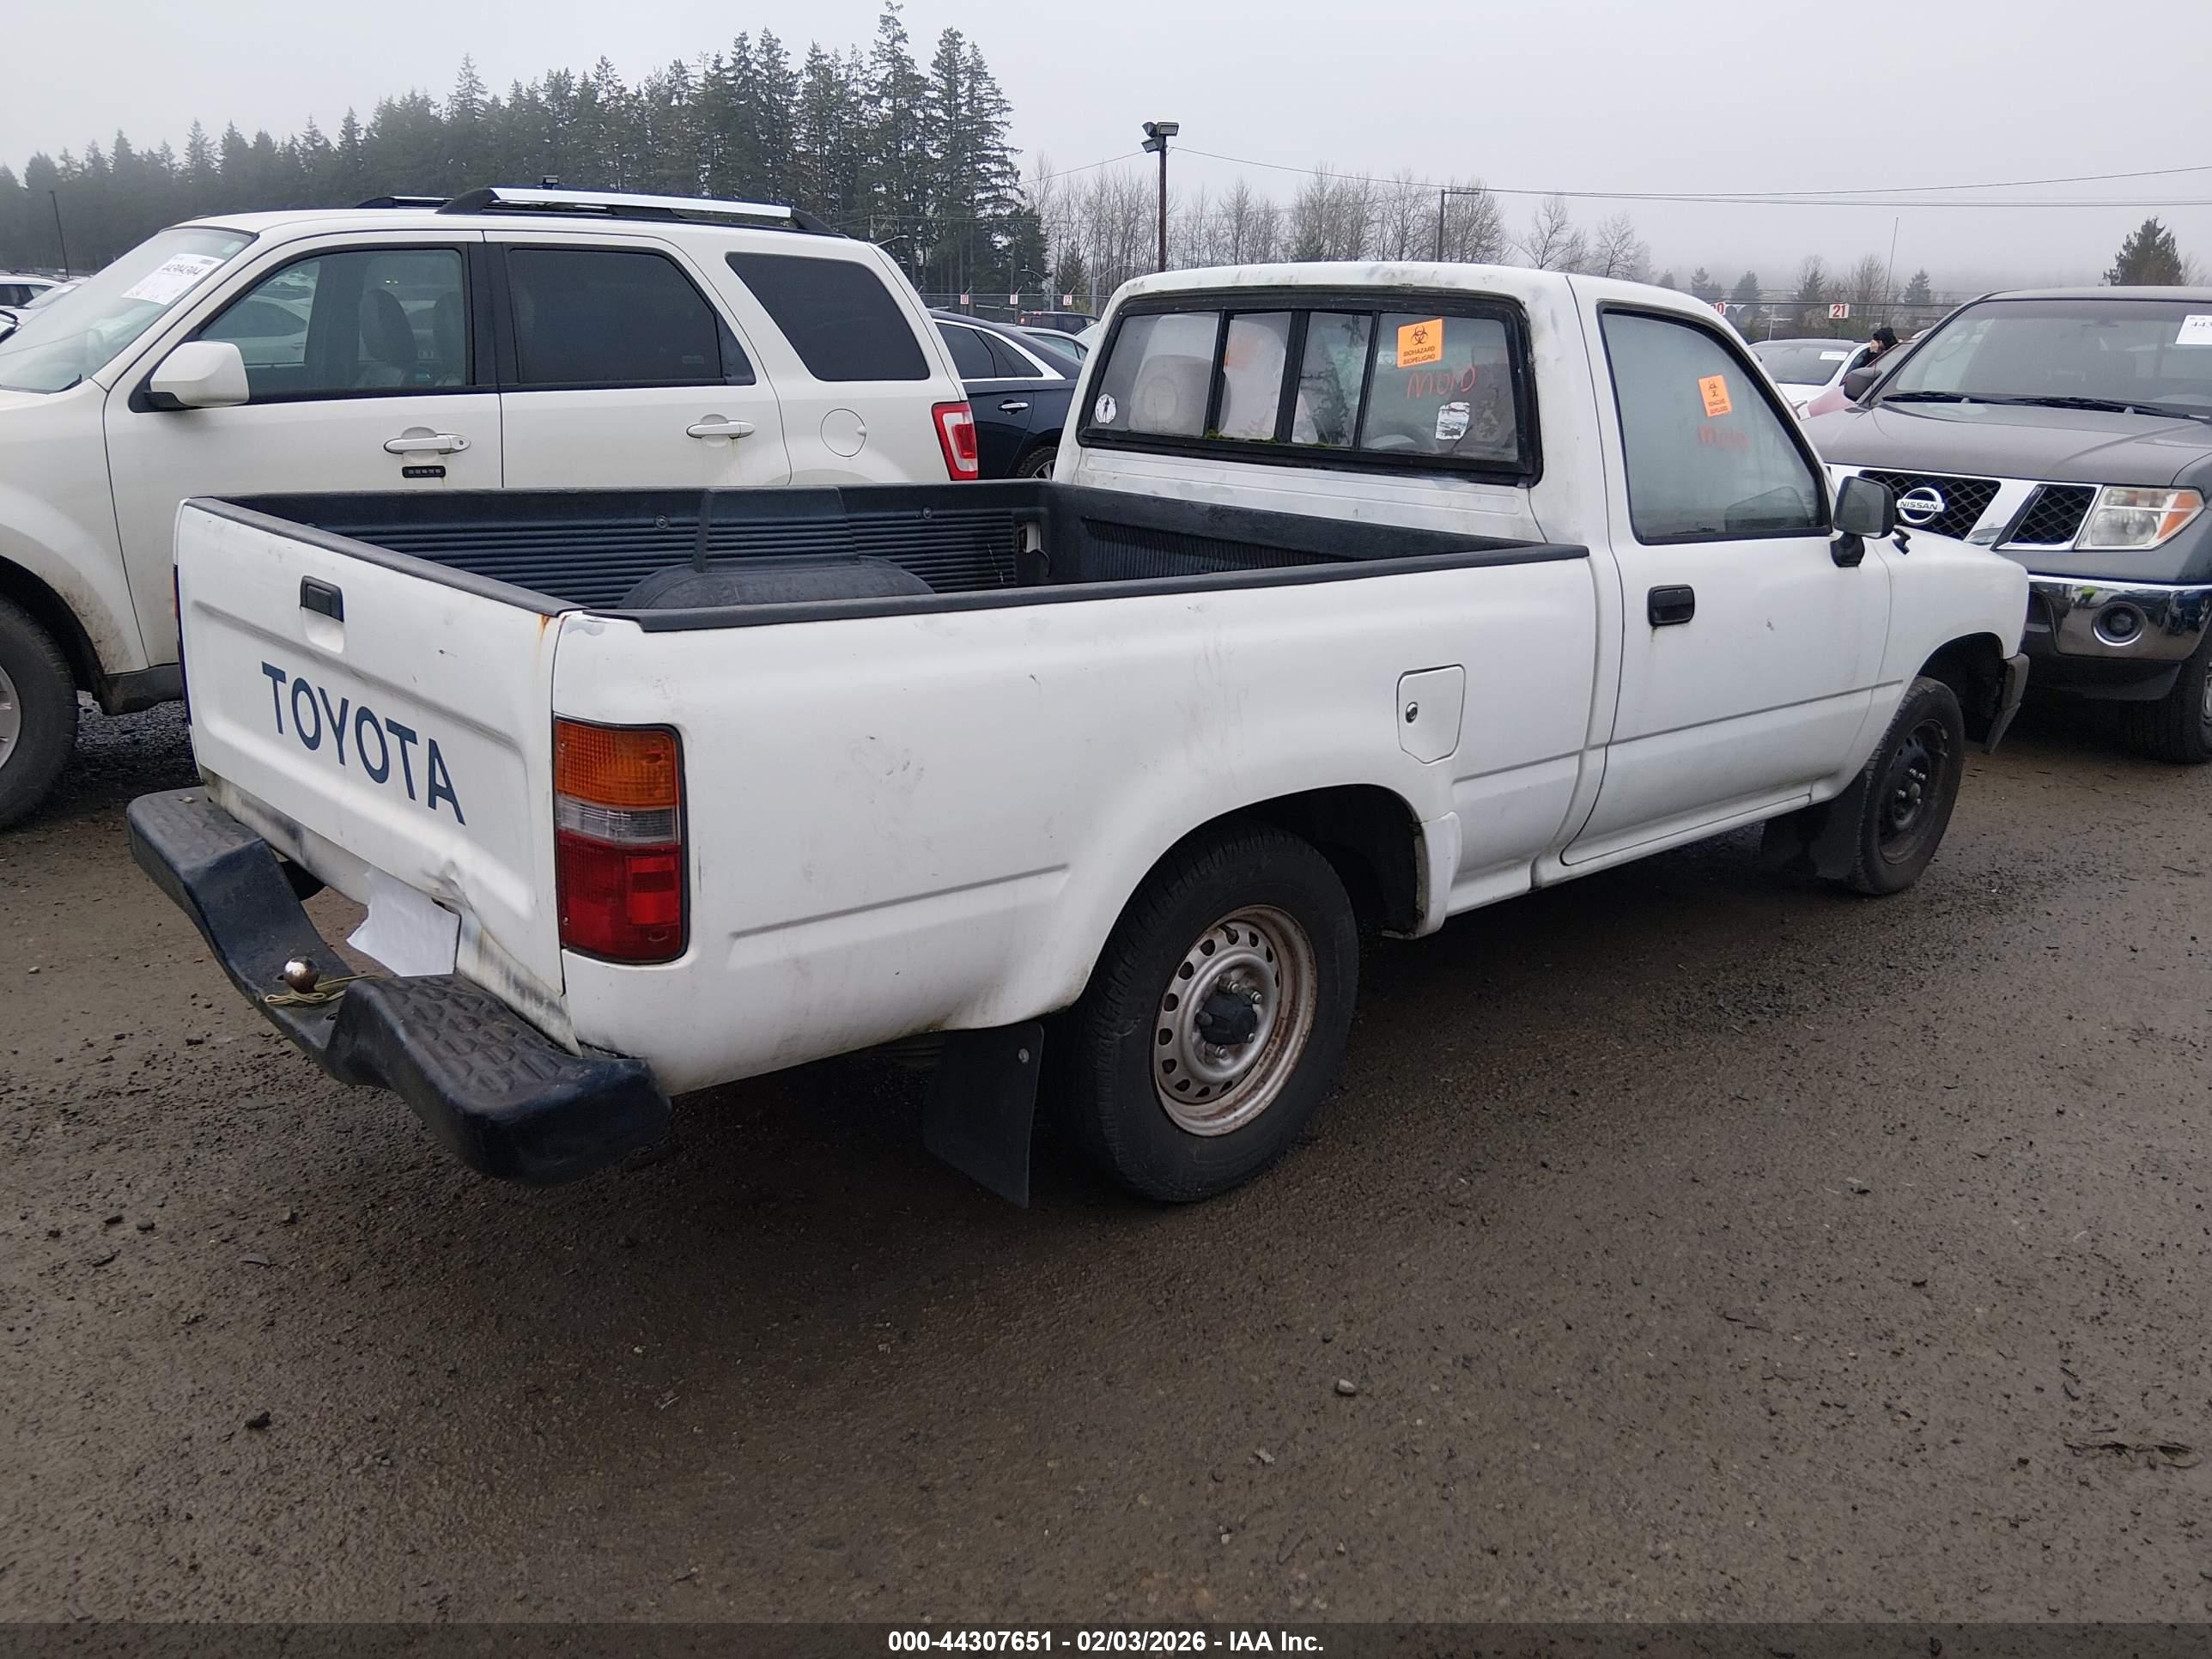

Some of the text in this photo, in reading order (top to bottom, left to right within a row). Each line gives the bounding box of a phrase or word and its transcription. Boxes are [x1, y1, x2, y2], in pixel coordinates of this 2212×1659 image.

[1832, 304, 1846, 318] 21
[1403, 345, 1436, 357] BIOHAZARD
[1403, 353, 1436, 364] BIOPELIGRO
[1899, 501, 1938, 510] NISSAN
[261, 660, 466, 826] TOYOTA
